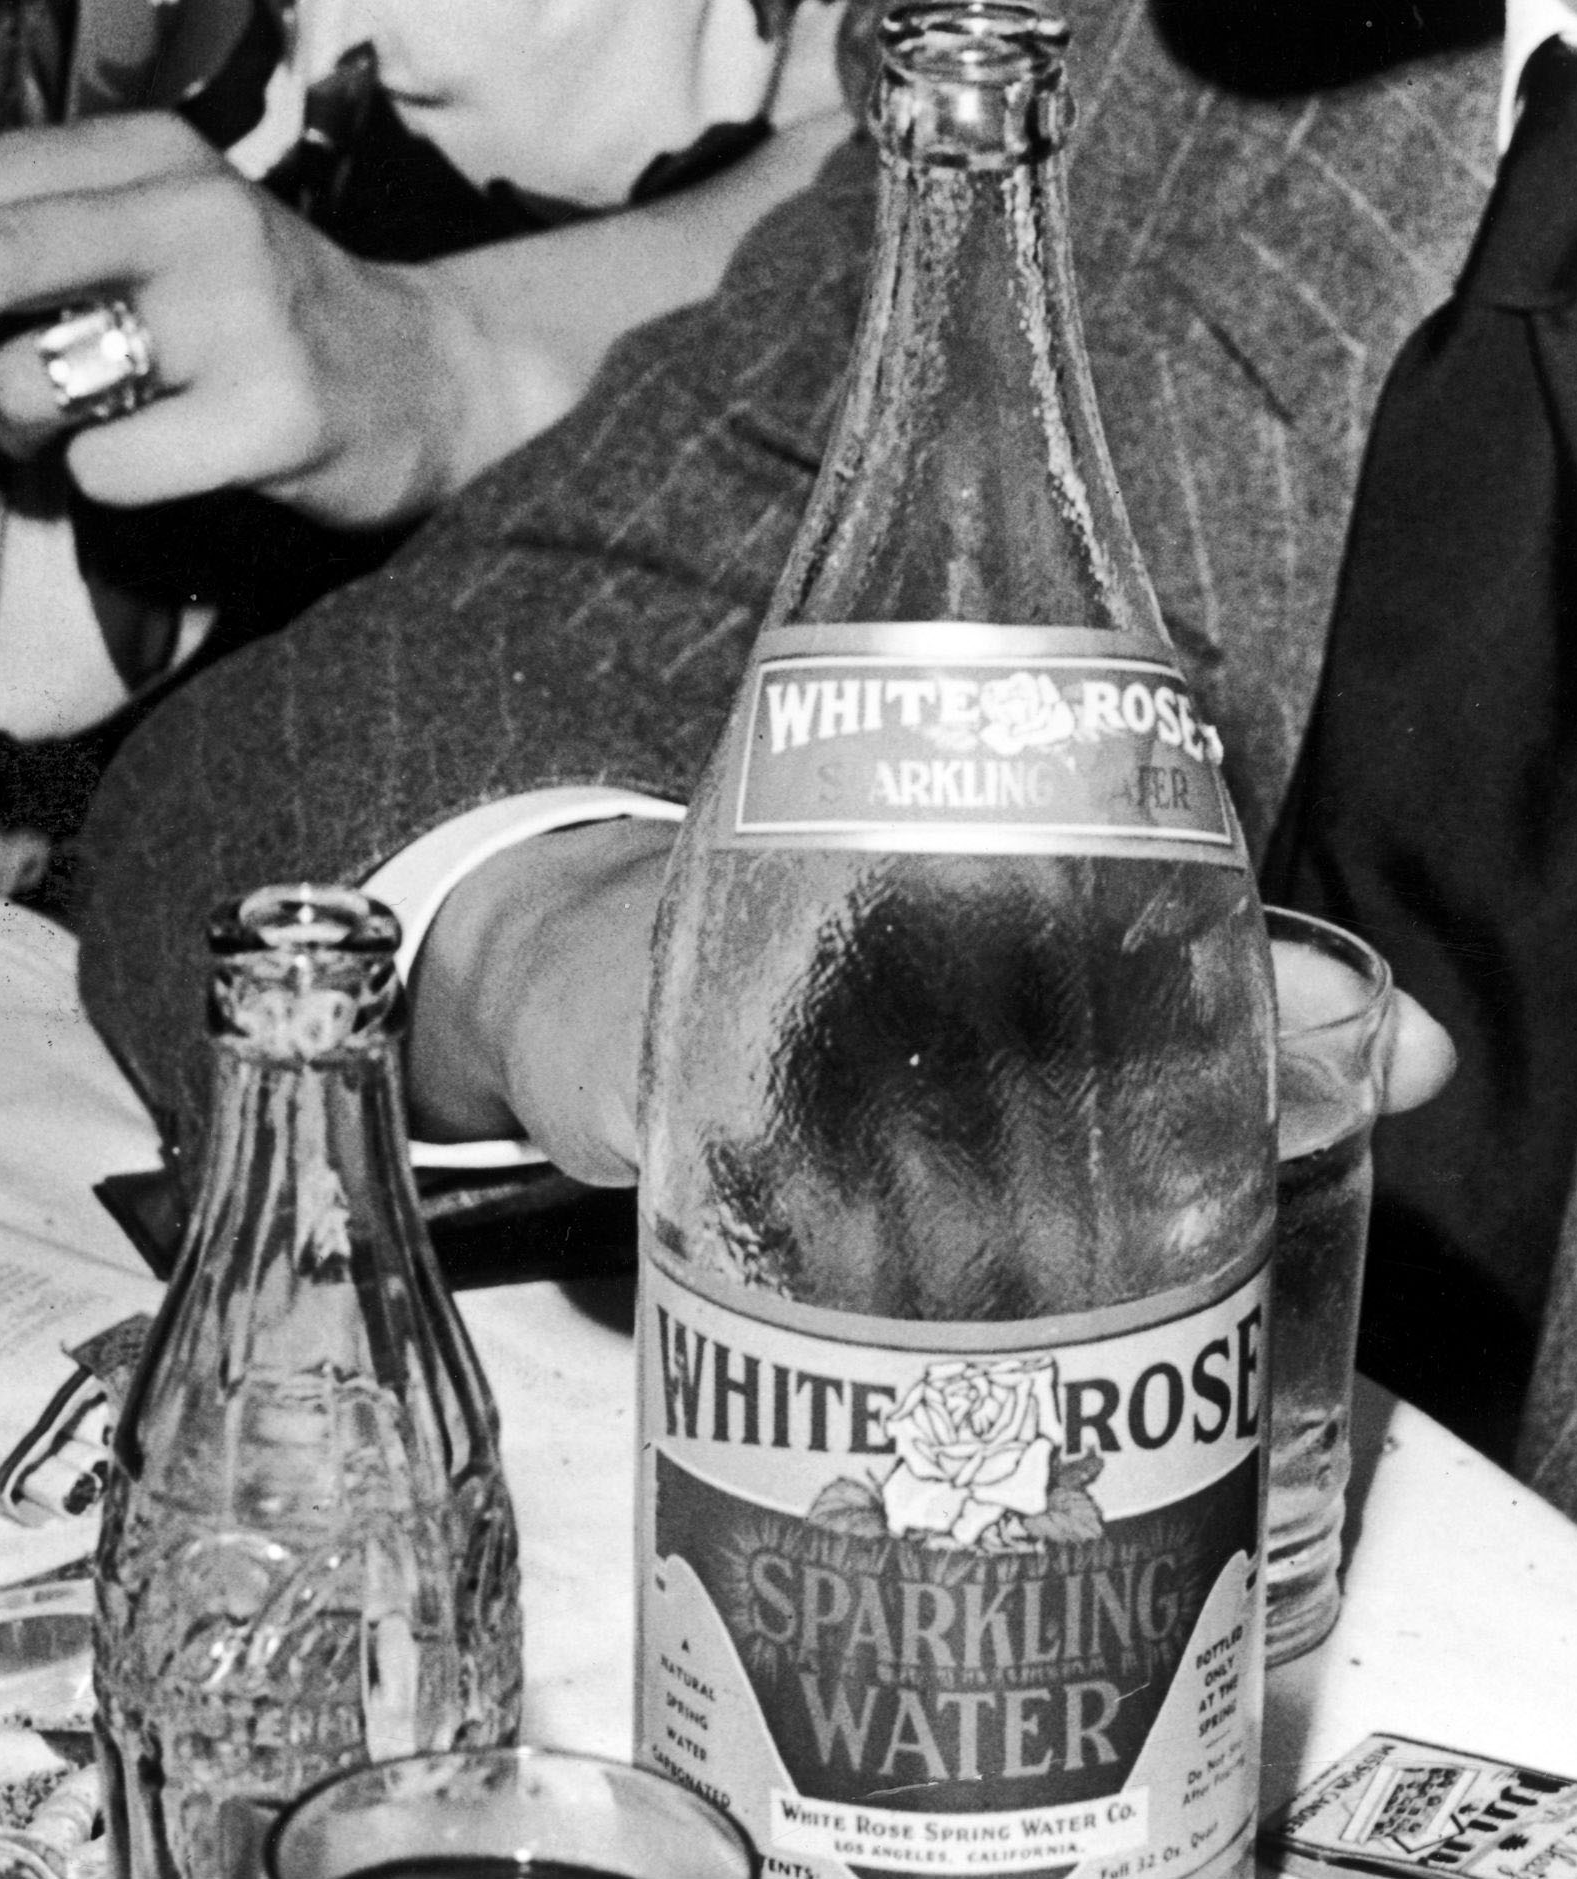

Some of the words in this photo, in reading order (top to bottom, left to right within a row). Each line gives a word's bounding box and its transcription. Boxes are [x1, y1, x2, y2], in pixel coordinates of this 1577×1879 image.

[766, 678, 981, 755] WHITE
[1083, 680, 1209, 762] ROSE
[657, 1303, 896, 1455] WHITE
[1063, 1302, 1262, 1456] ROSE
[751, 1552, 1180, 1669] SPARKLING
[1195, 1624, 1244, 1670] BOTTLED
[660, 1653, 716, 1702] NATURAL
[666, 1690, 709, 1731] SPRING
[799, 1671, 1121, 1780] WATER
[1199, 1691, 1216, 1713] AT
[666, 1724, 708, 1763] WATER
[834, 1840, 864, 1854] LOS
